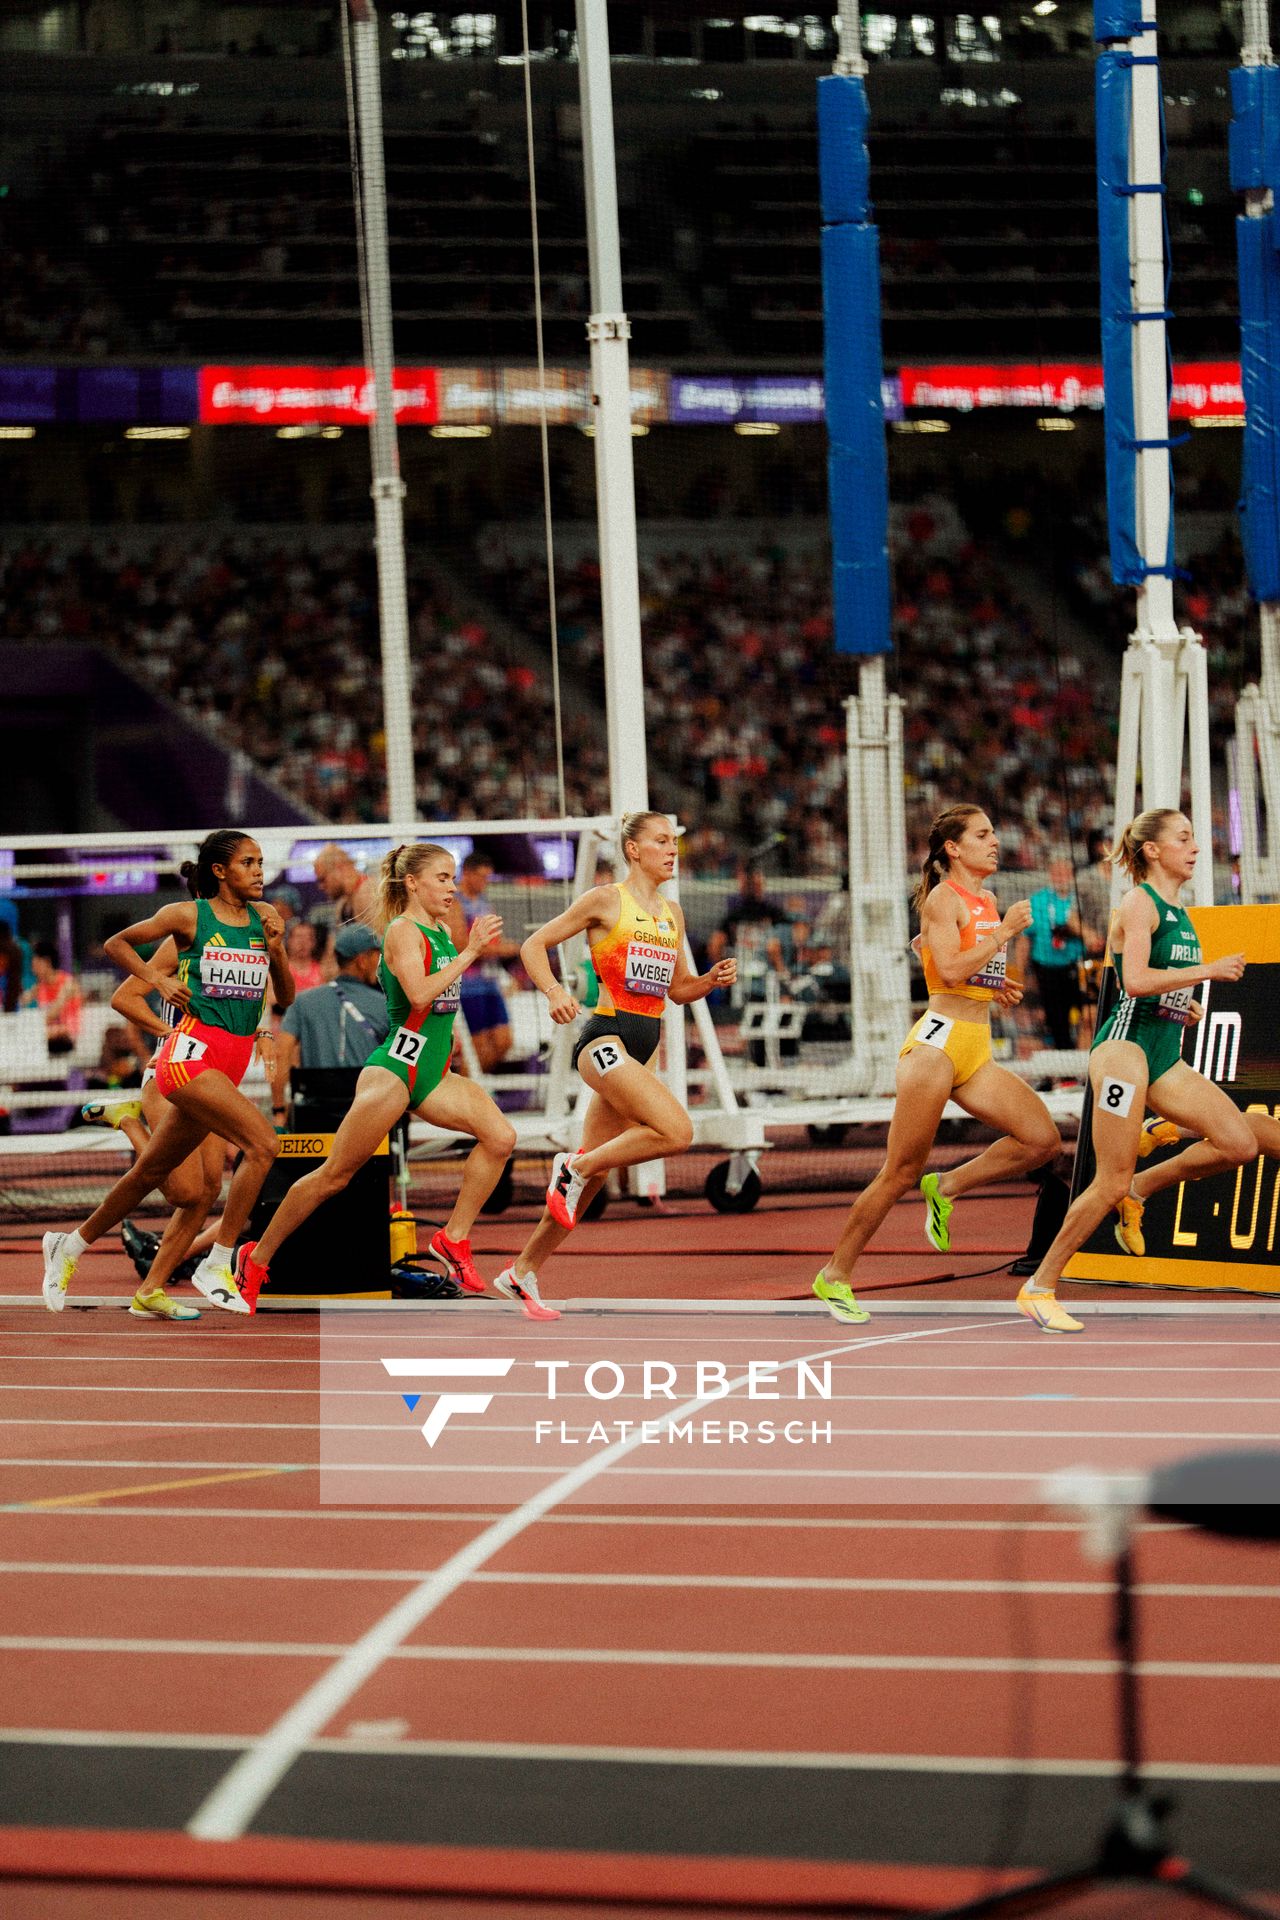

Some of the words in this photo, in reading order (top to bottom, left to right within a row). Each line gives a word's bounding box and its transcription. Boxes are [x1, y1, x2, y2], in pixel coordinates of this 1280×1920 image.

[204, 951, 268, 966] HONDA
[210, 967, 262, 987] HAILU
[925, 1018, 945, 1040] 7
[395, 1033, 420, 1062] 12
[593, 1046, 618, 1070] 13
[1106, 1084, 1124, 1108] 8
